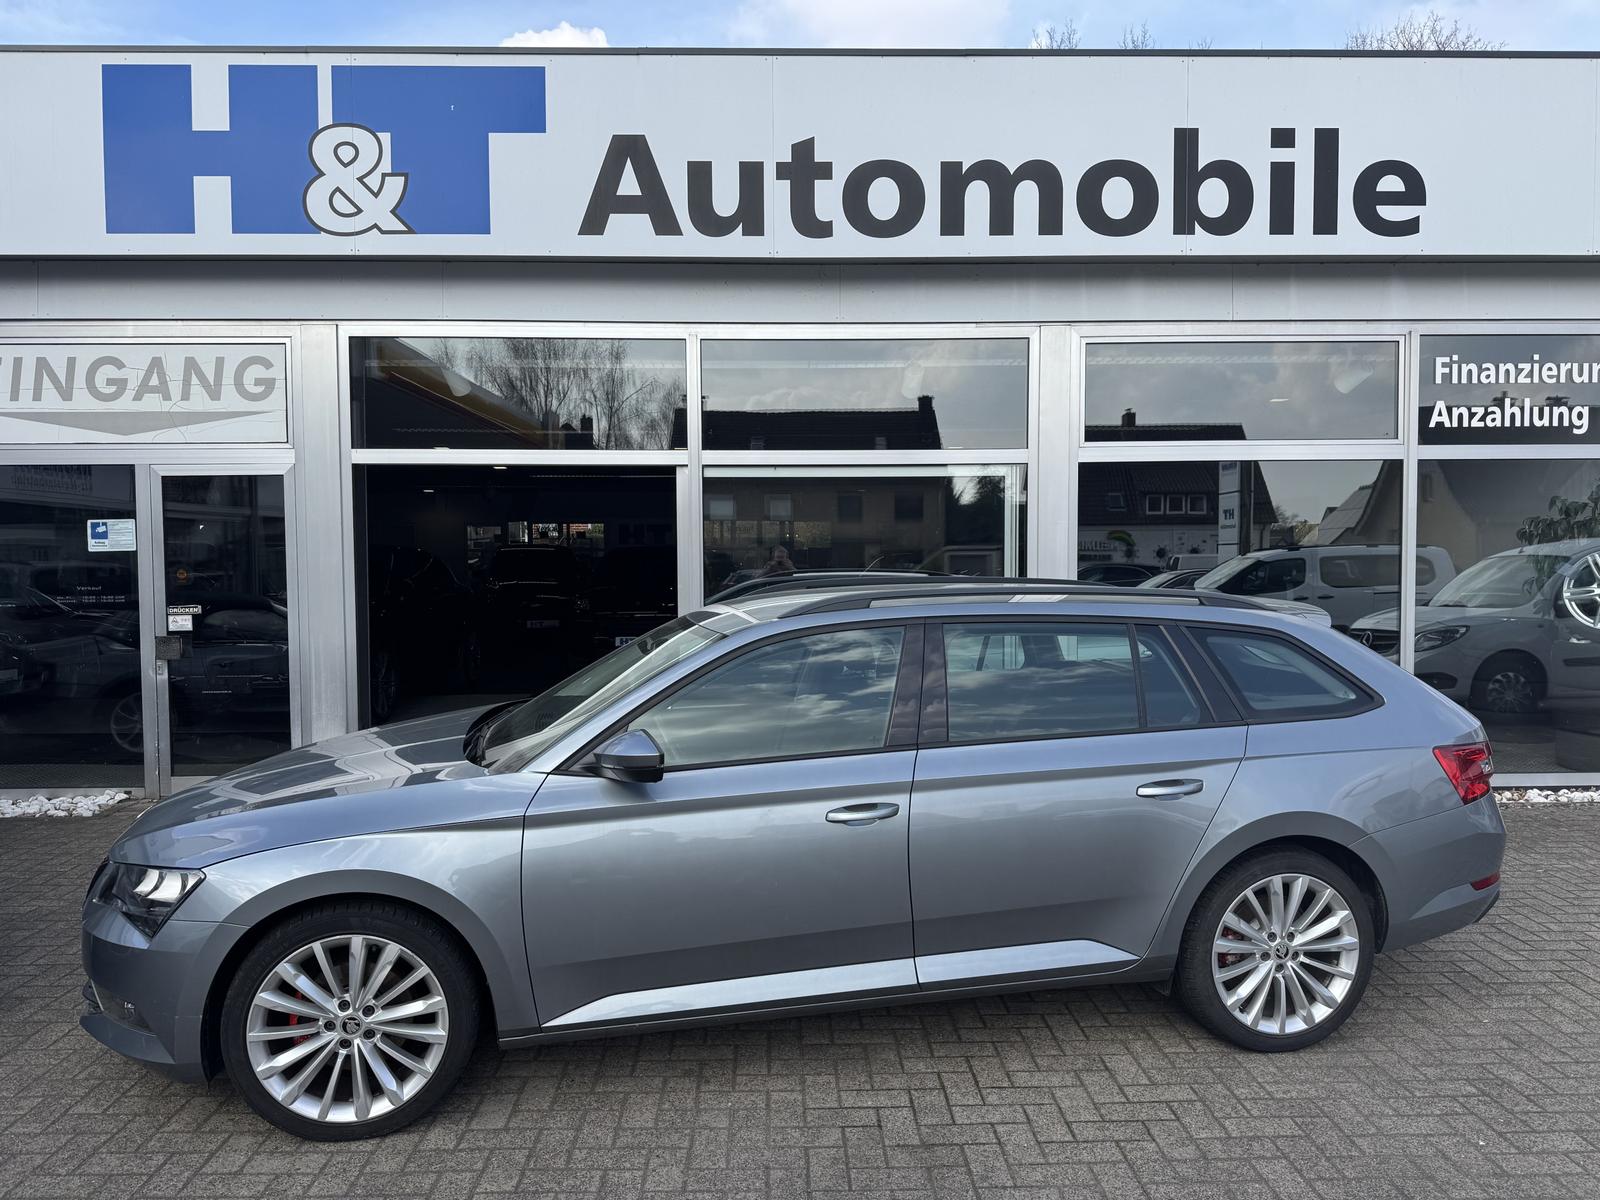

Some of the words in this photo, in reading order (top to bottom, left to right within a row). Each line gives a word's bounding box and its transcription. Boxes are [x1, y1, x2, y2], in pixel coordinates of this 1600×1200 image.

[102, 64, 547, 236] H&T
[578, 127, 1428, 239] Automobile
[0, 355, 282, 403] INGANG
[1428, 397, 1590, 435] Anzahlung
